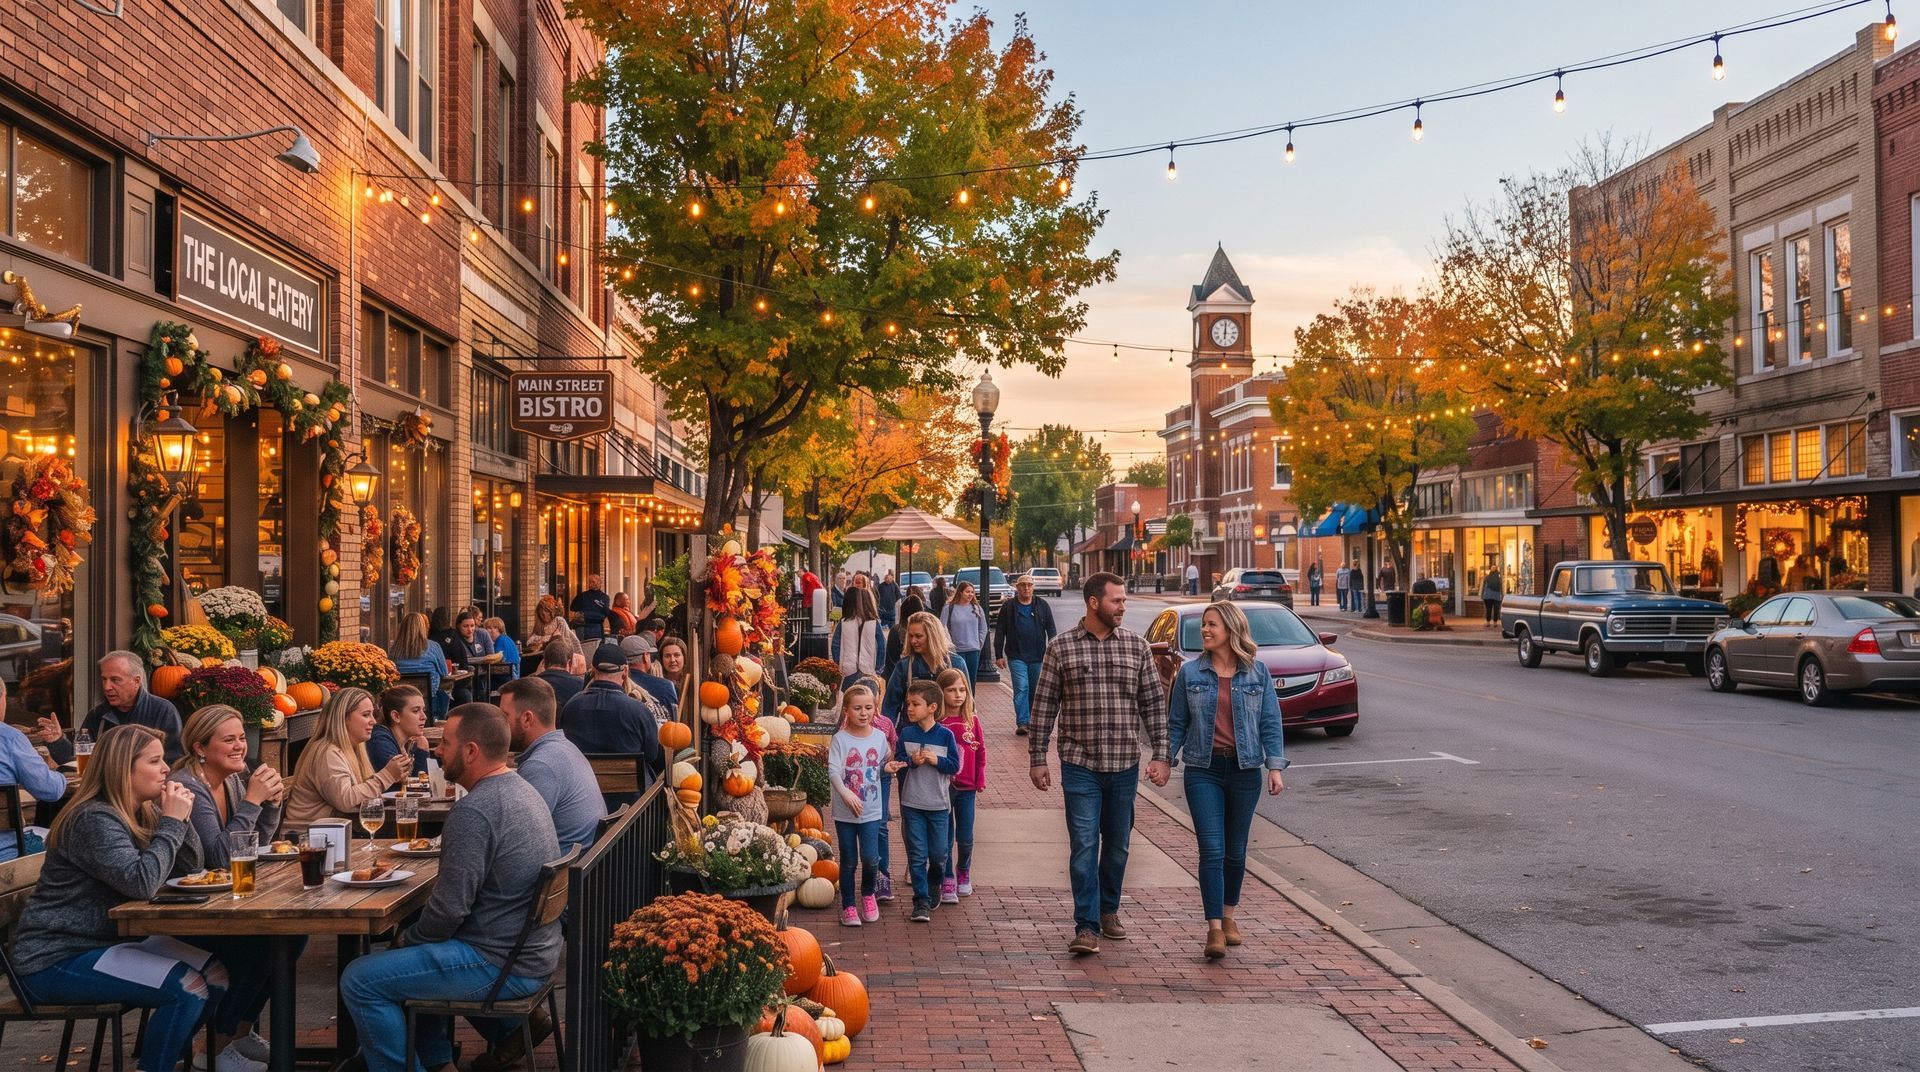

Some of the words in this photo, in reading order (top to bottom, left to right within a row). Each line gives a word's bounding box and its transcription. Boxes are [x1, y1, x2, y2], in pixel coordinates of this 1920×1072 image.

[184, 234, 215, 290] THE
[219, 251, 265, 312] LOCAL
[268, 276, 314, 333] EATERY
[517, 379, 552, 392] MAIN
[555, 379, 605, 392] STREET
[519, 396, 603, 417] BISTRO
